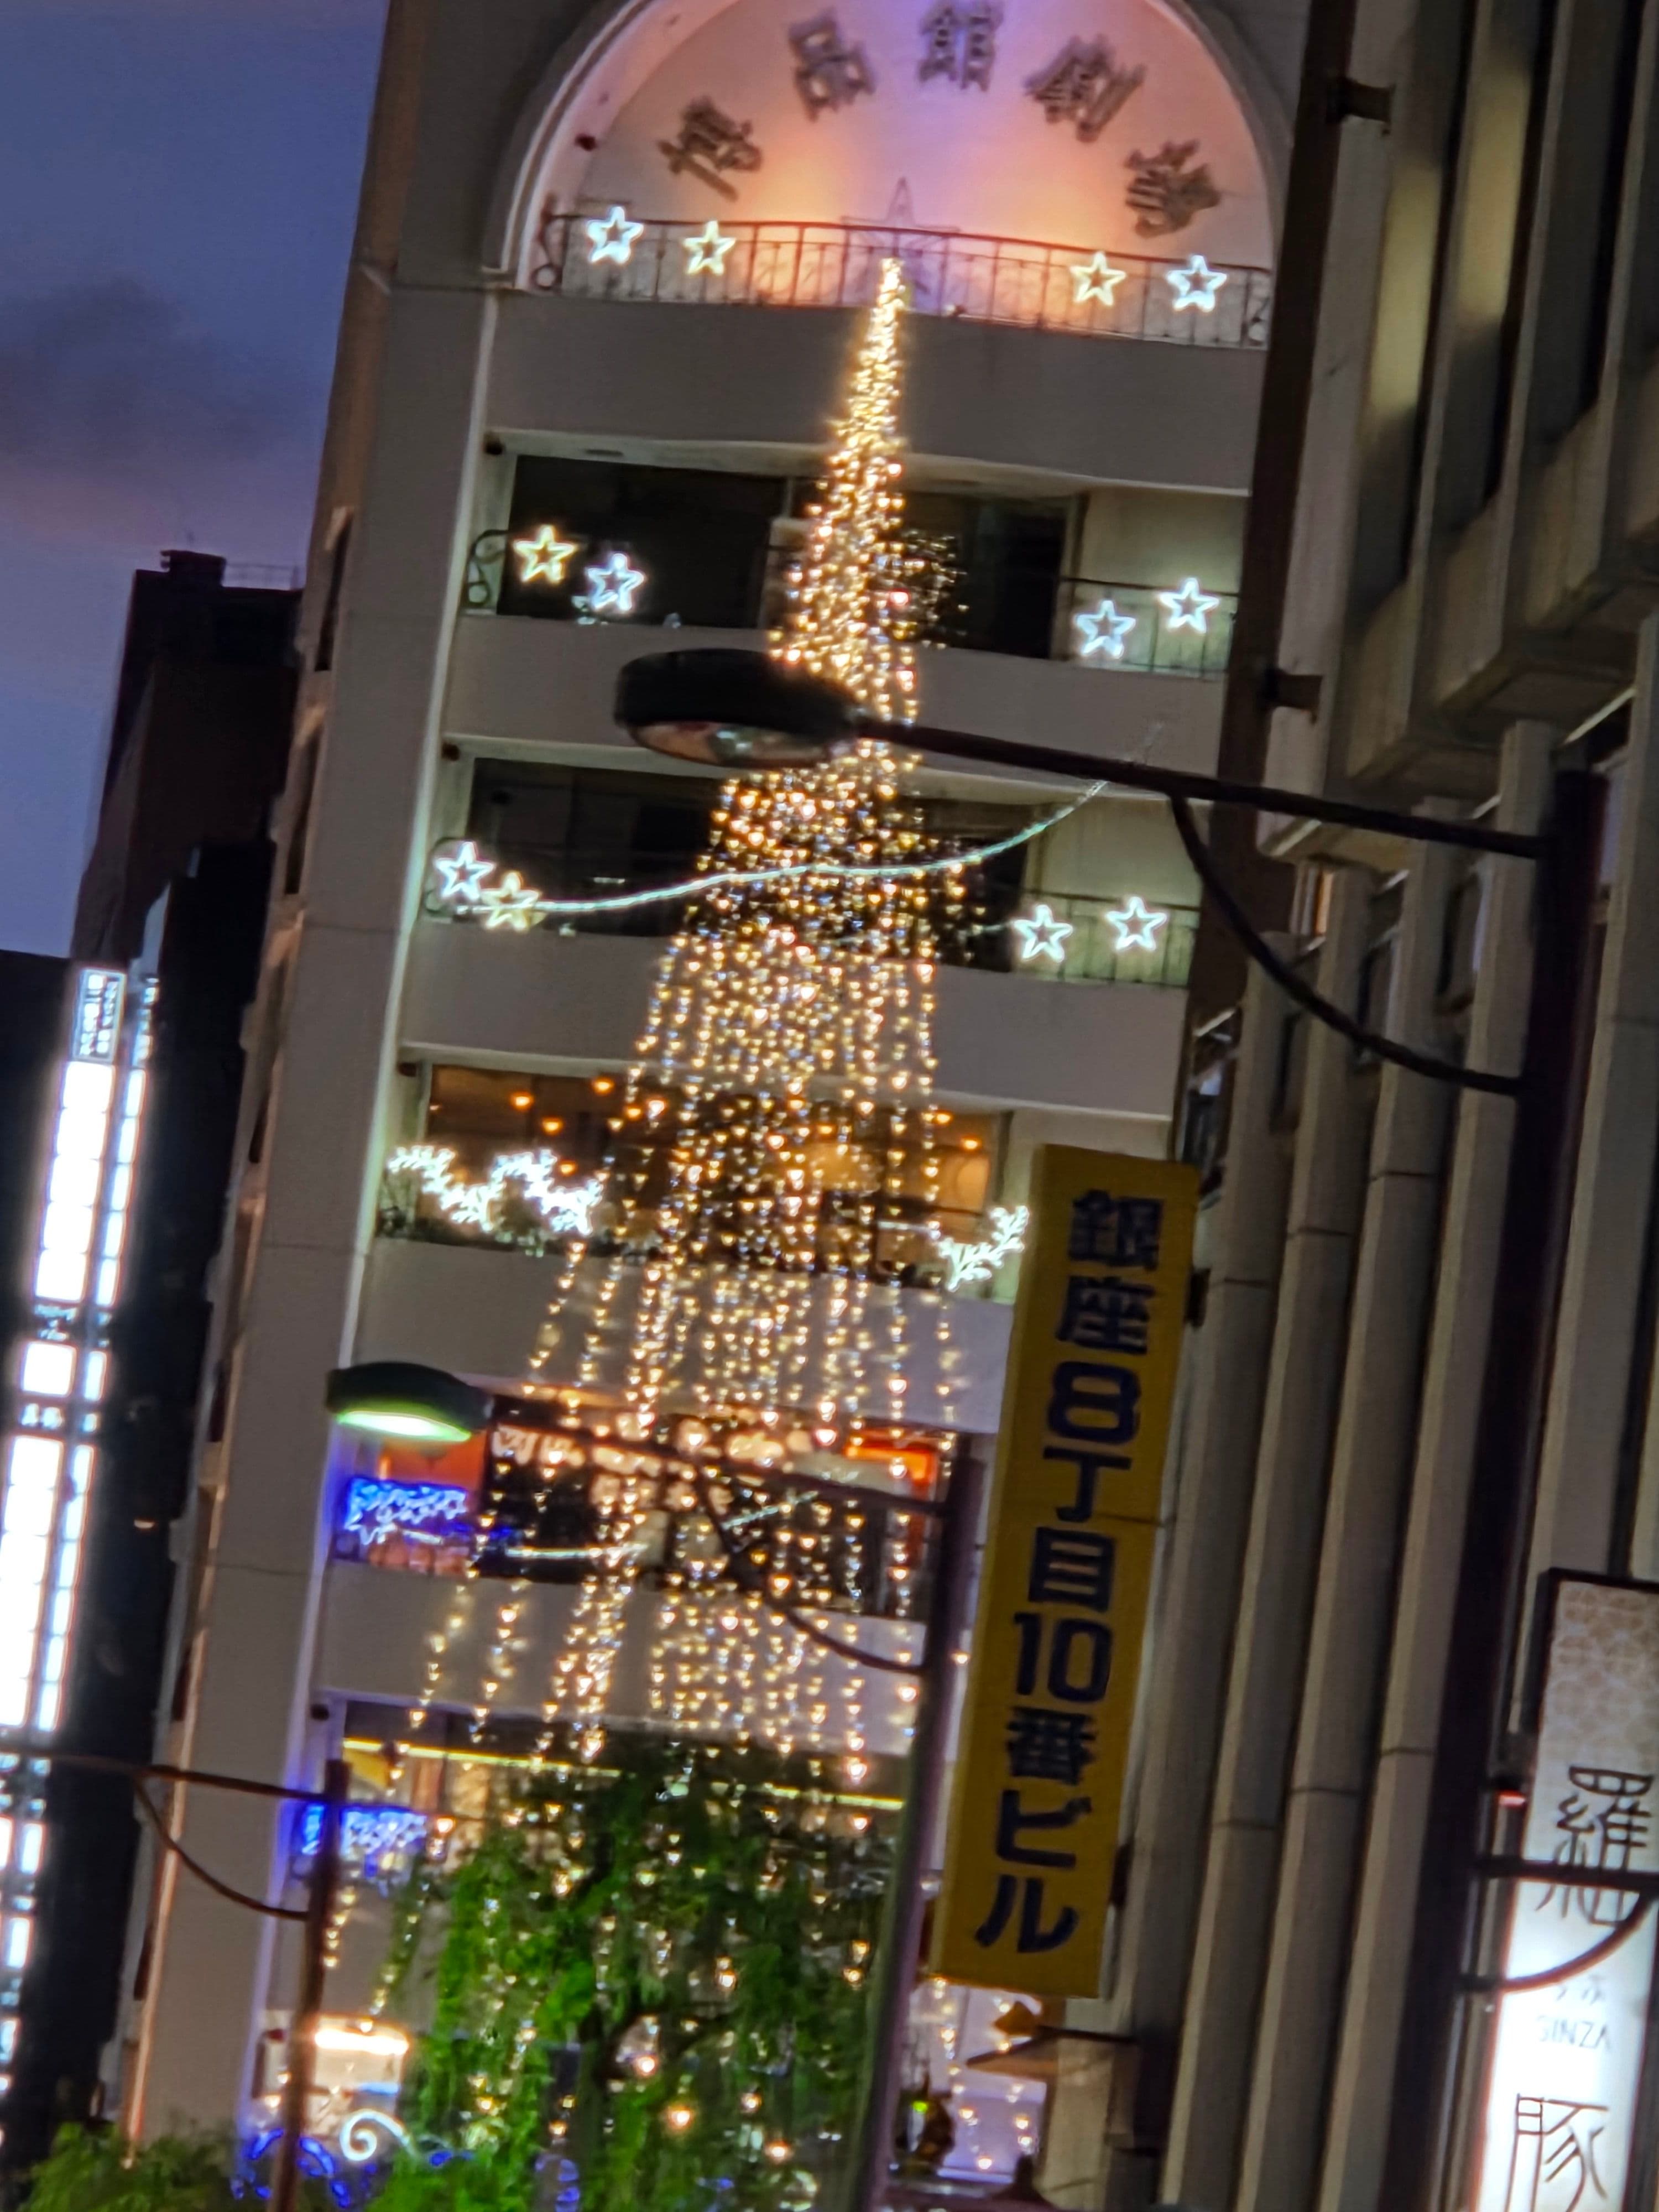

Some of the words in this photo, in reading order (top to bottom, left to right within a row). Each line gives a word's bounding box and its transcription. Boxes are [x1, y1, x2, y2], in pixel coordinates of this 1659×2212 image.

[974, 1188, 1164, 1954] 銀座8丁目10番ビル
